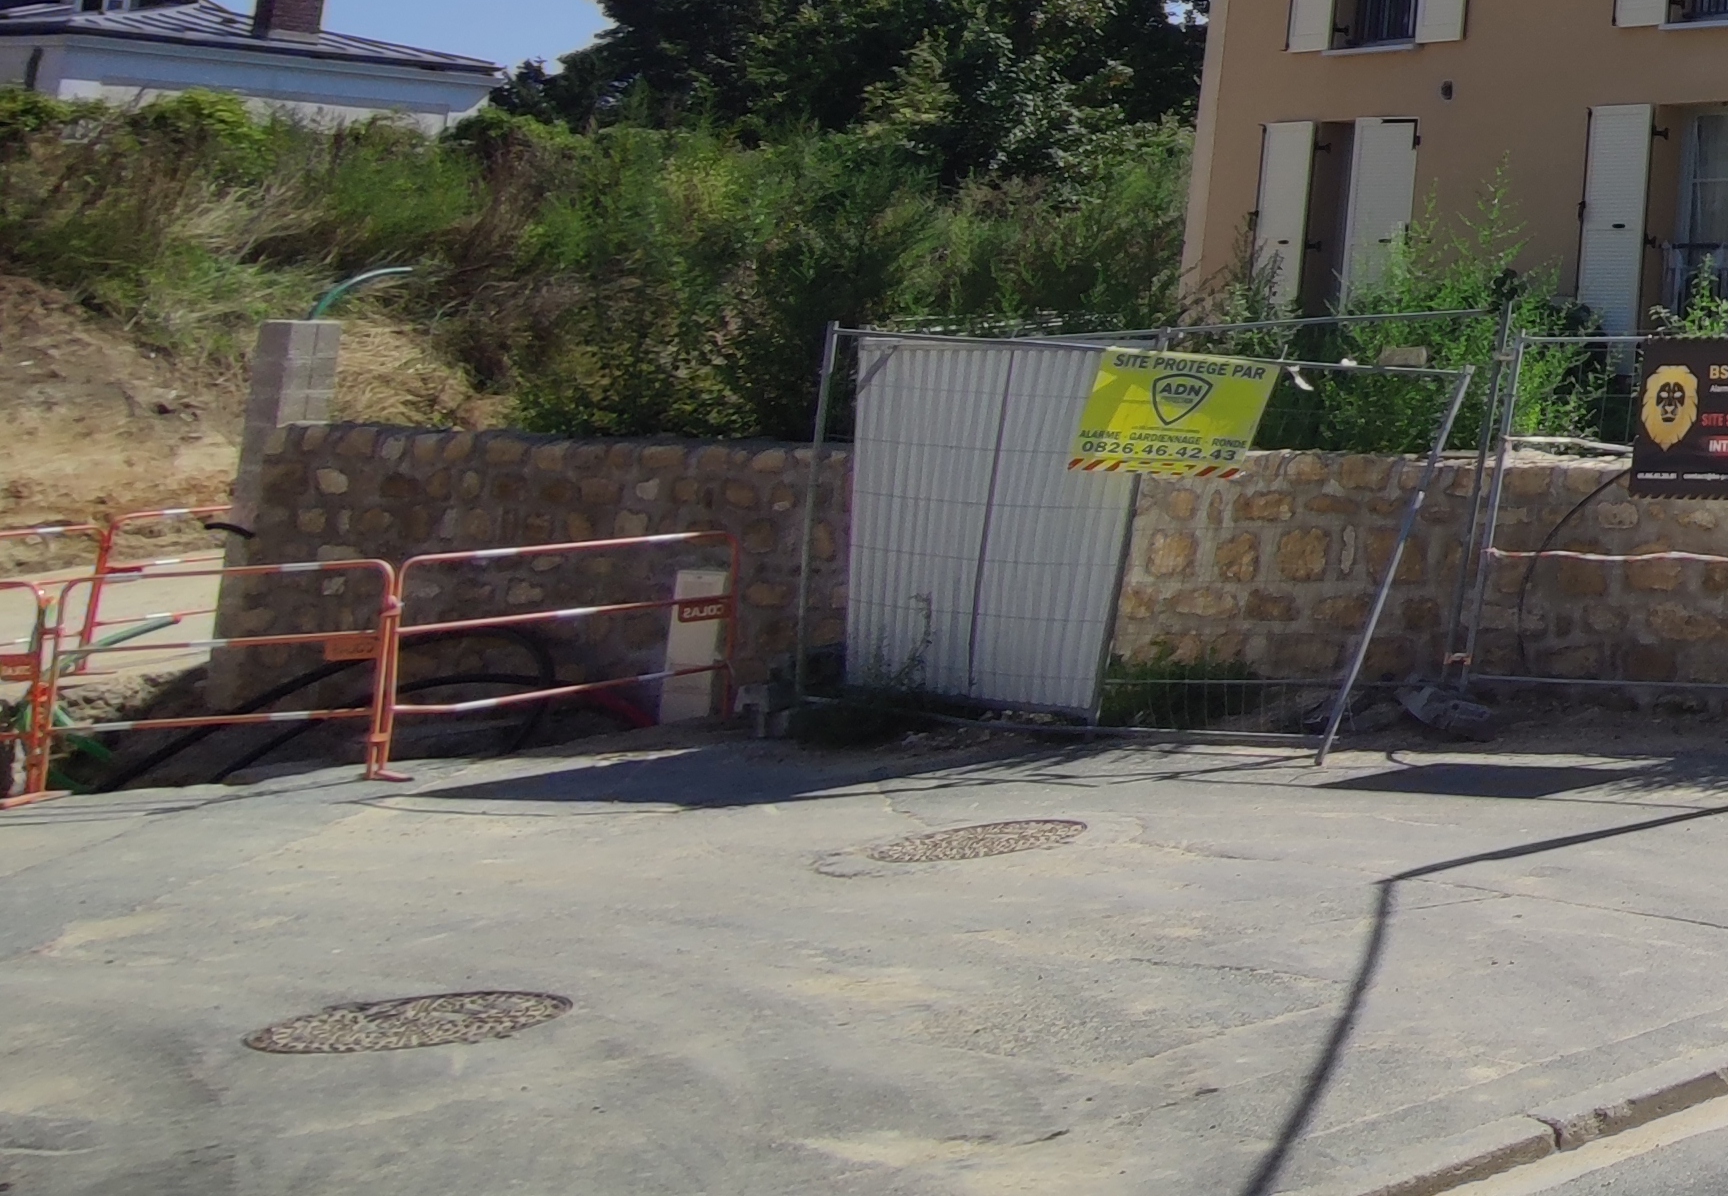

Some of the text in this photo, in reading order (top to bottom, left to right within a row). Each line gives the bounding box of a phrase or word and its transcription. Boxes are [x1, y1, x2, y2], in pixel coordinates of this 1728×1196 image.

[1113, 353, 1266, 380] SITE PROTÉGÉ PAR
[1159, 382, 1203, 397] ADN
[1701, 413, 1724, 426] SITE
[1078, 429, 1122, 441] ALARME
[1129, 431, 1203, 445] GARDIENNAGE
[1211, 438, 1248, 449] RONDE
[1081, 440, 1237, 462] 0826.46.42.43
